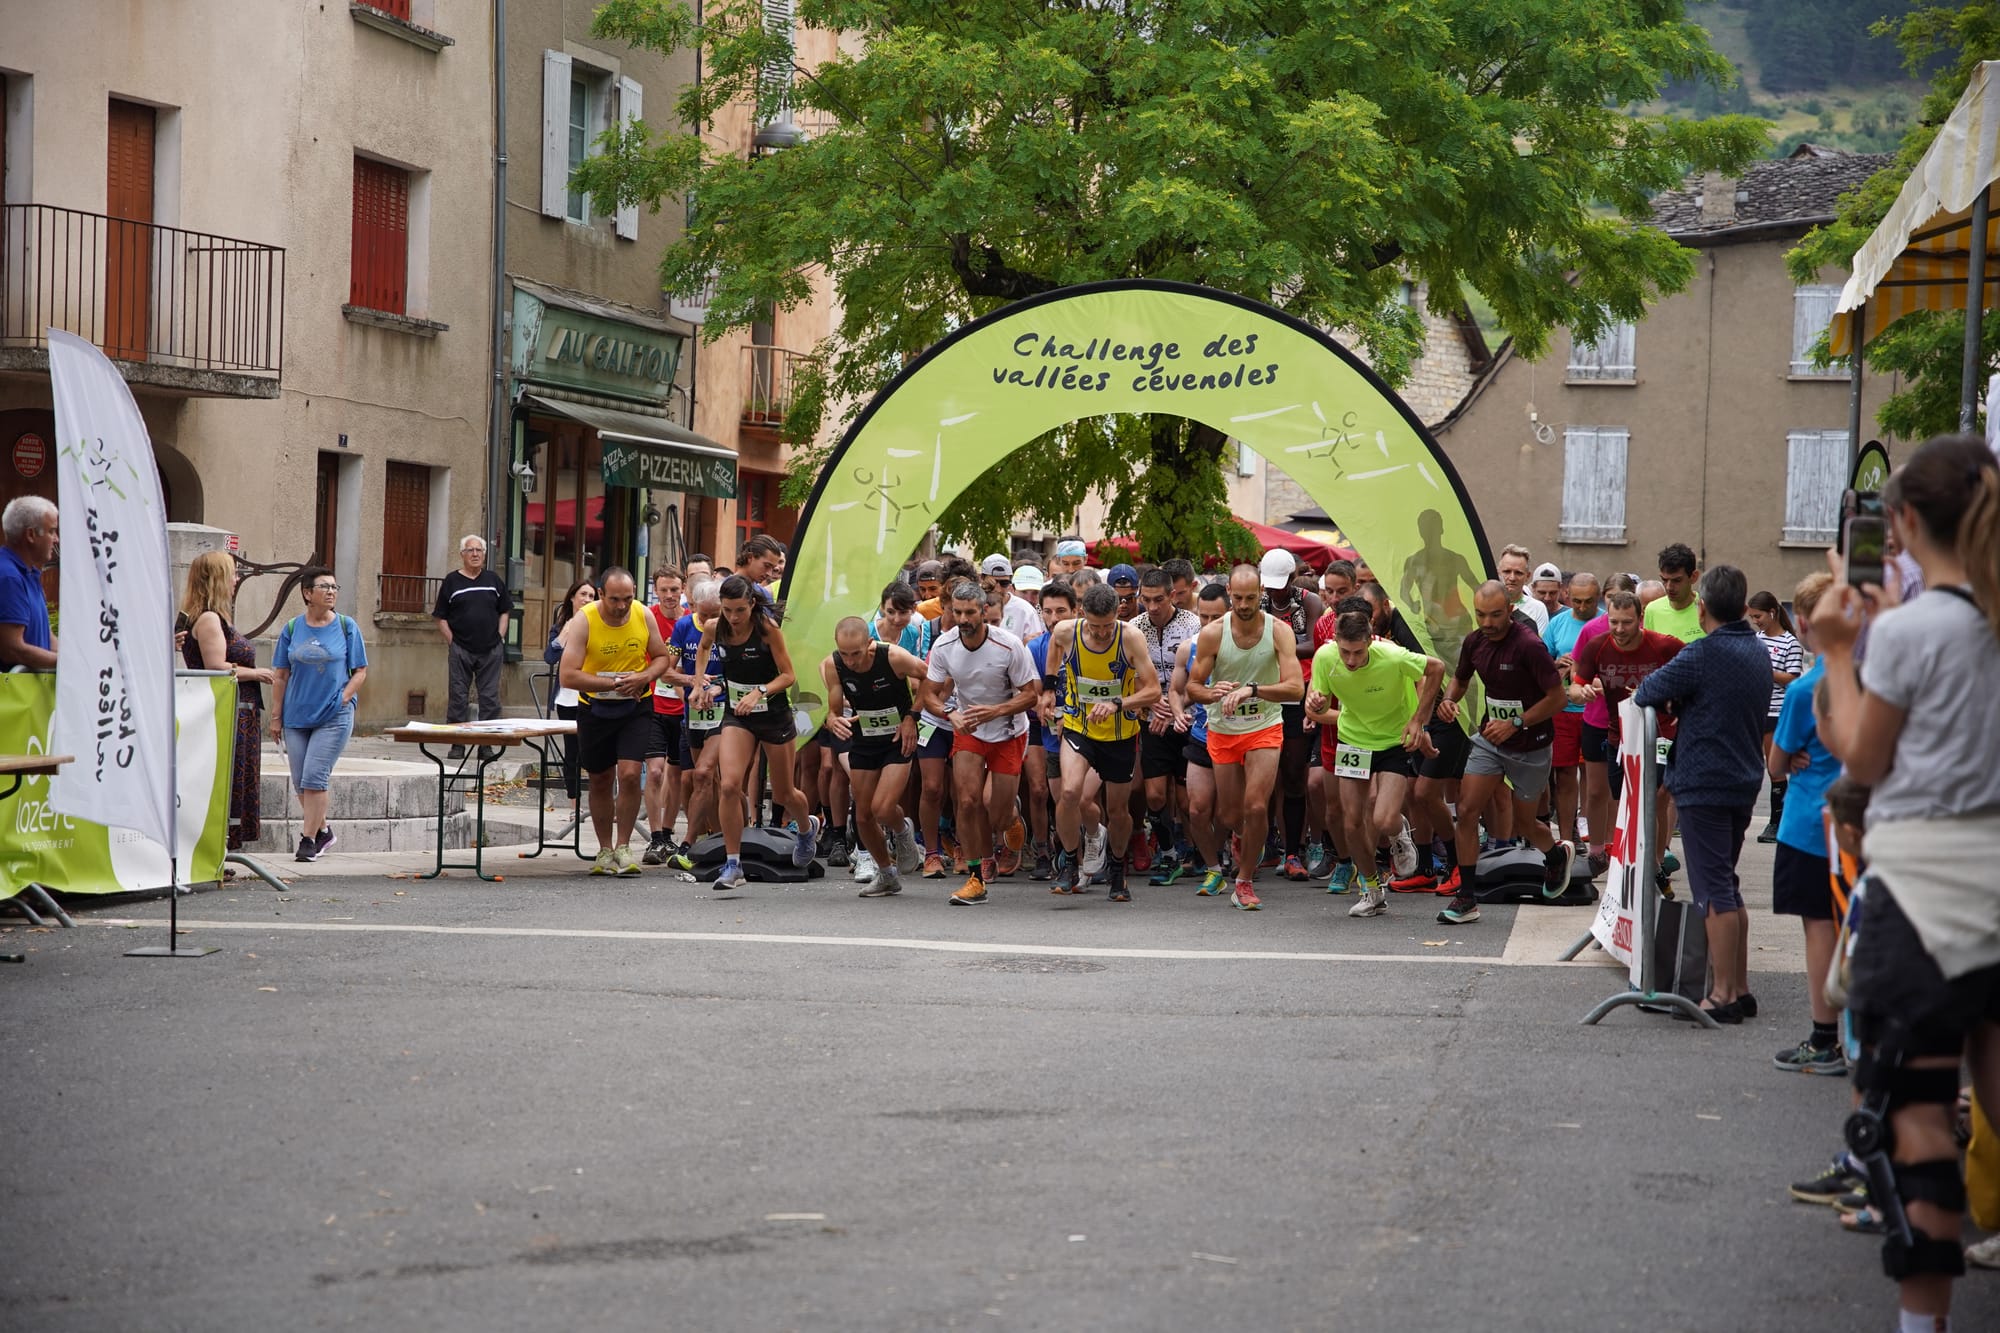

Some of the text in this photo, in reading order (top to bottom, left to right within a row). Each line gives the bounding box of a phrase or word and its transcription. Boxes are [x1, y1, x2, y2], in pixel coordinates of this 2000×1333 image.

[548, 327, 679, 384] AU GALETON
[1013, 332, 1259, 370] Challenge des
[993, 363, 1279, 392] vallées cévenoles
[602, 447, 623, 470] PIZZA
[640, 453, 704, 488] PIZZERIA
[713, 460, 733, 487] PIZZA
[1089, 686, 1110, 697] 48
[697, 709, 715, 721] 18
[869, 716, 890, 728] 55
[1491, 706, 1518, 720] 104
[1341, 753, 1360, 767] 43
